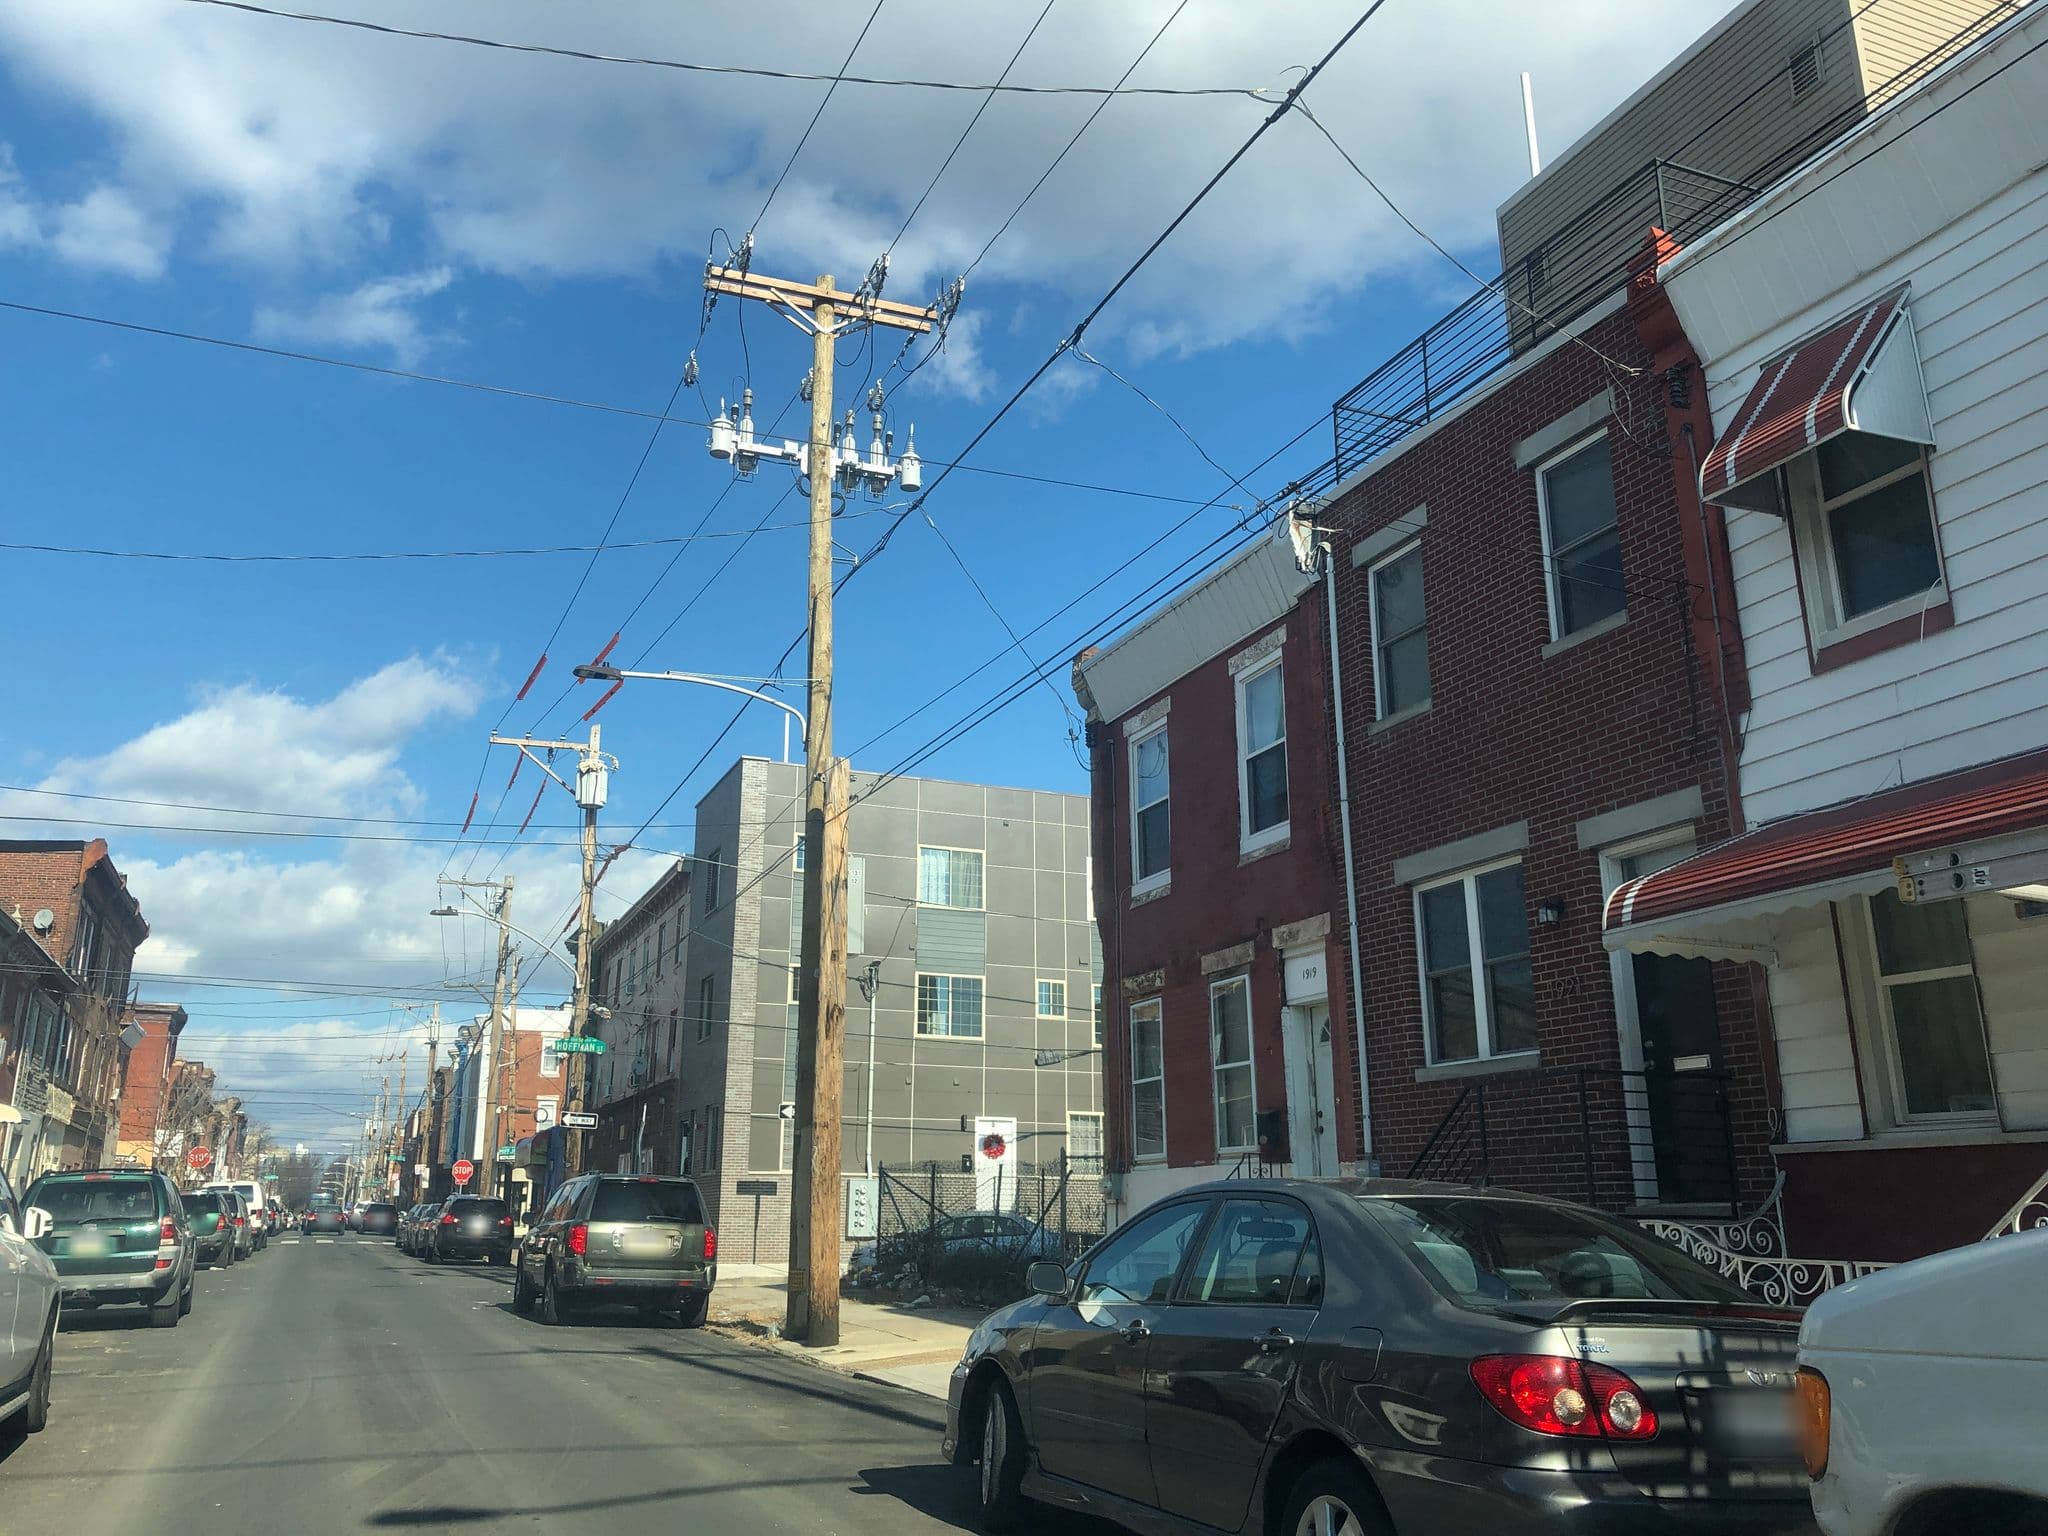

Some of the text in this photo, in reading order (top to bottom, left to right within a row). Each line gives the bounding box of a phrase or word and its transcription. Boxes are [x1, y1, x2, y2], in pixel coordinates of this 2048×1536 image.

[1302, 966, 1317, 980] 1919
[556, 1041, 595, 1052] HOFFMAN
[454, 1166, 472, 1175] STOP
